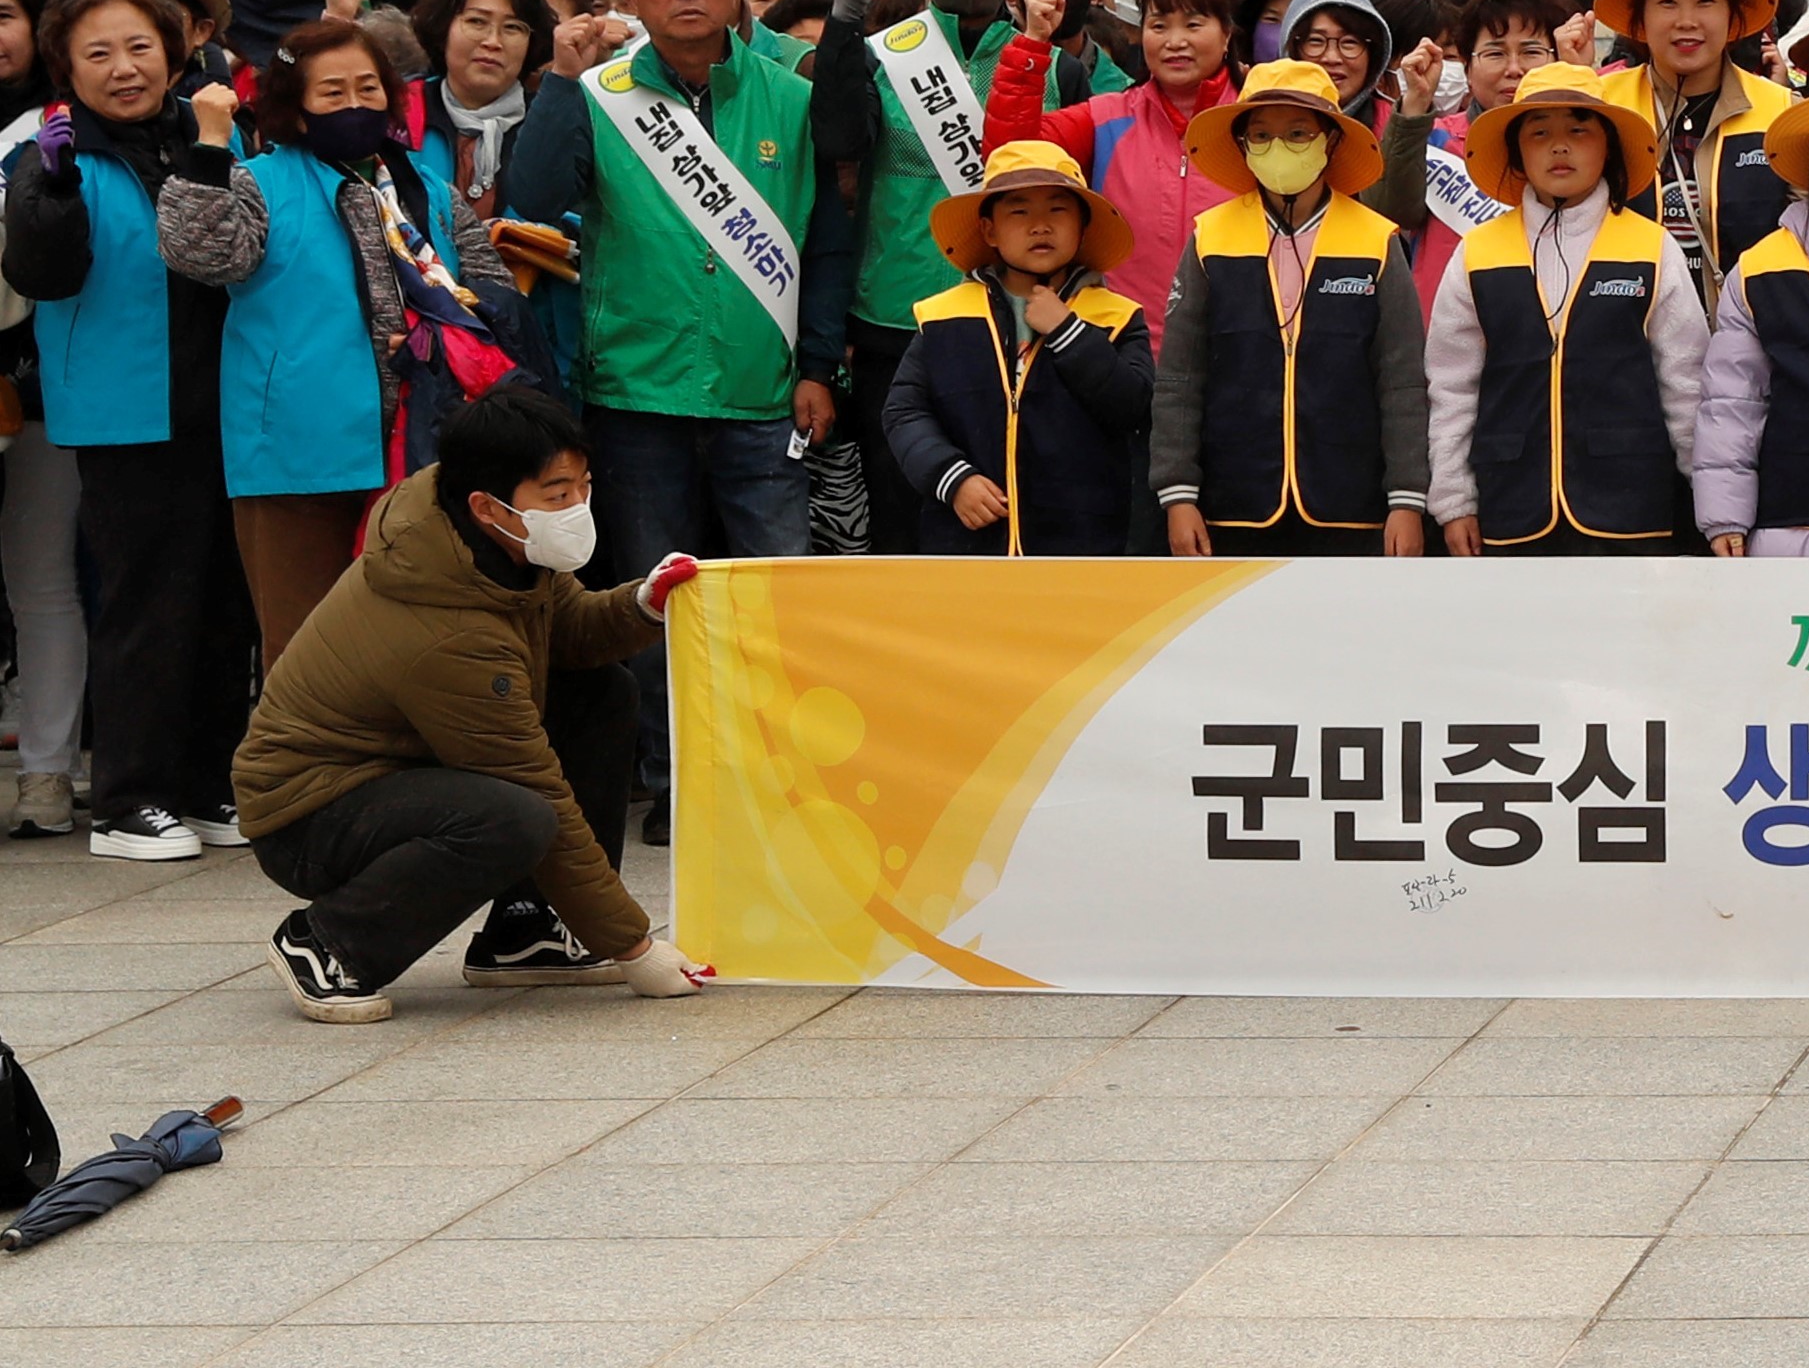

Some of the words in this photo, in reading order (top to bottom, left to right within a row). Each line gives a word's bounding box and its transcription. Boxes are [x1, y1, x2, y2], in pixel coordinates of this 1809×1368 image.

[910, 65, 958, 116] 내집
[635, 101, 685, 153] 내집
[672, 144, 737, 218] 상가앞
[721, 207, 795, 297] 청소하기
[1191, 720, 1667, 867] 군민중심
